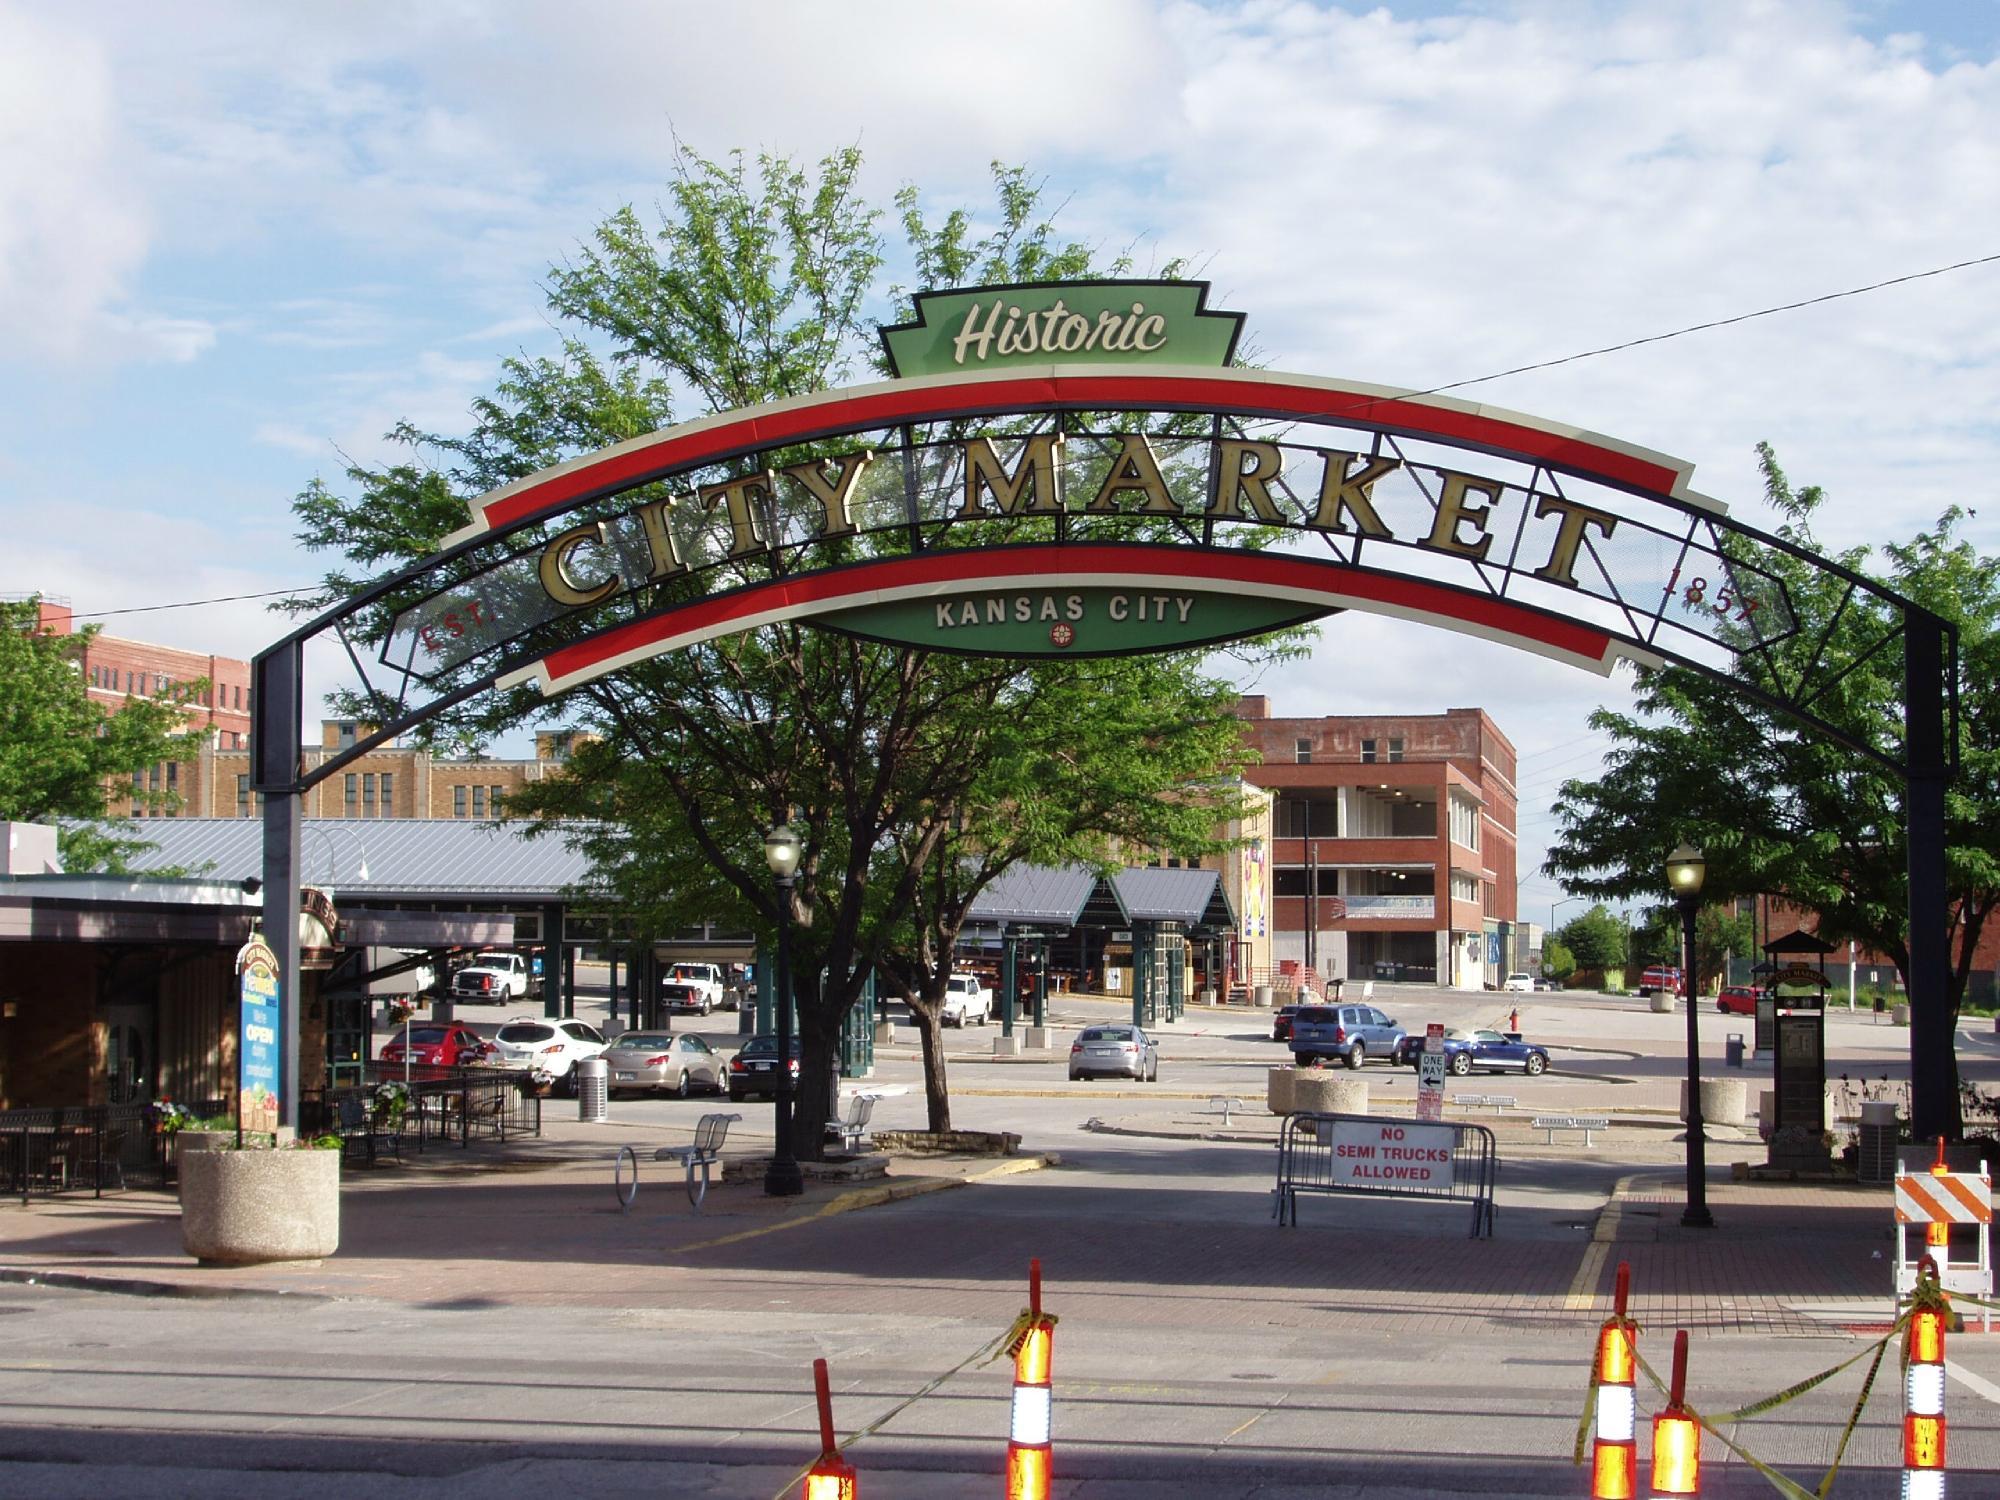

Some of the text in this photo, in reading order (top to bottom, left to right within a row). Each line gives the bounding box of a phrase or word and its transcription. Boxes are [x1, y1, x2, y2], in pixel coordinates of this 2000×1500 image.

[953, 299, 1168, 364] Historic
[538, 433, 1620, 607] CITY MARKET
[1662, 568, 1759, 621] 1857
[936, 594, 1196, 628] KANSAS CITY
[245, 1023, 274, 1045] OPEN
[1423, 1055, 1442, 1065] ONE
[1422, 1066, 1443, 1075] WAY
[1381, 1127, 1405, 1141] NO
[1337, 1145, 1449, 1162] SEMI TRUCKS
[1352, 1165, 1431, 1180] ALLOWED
